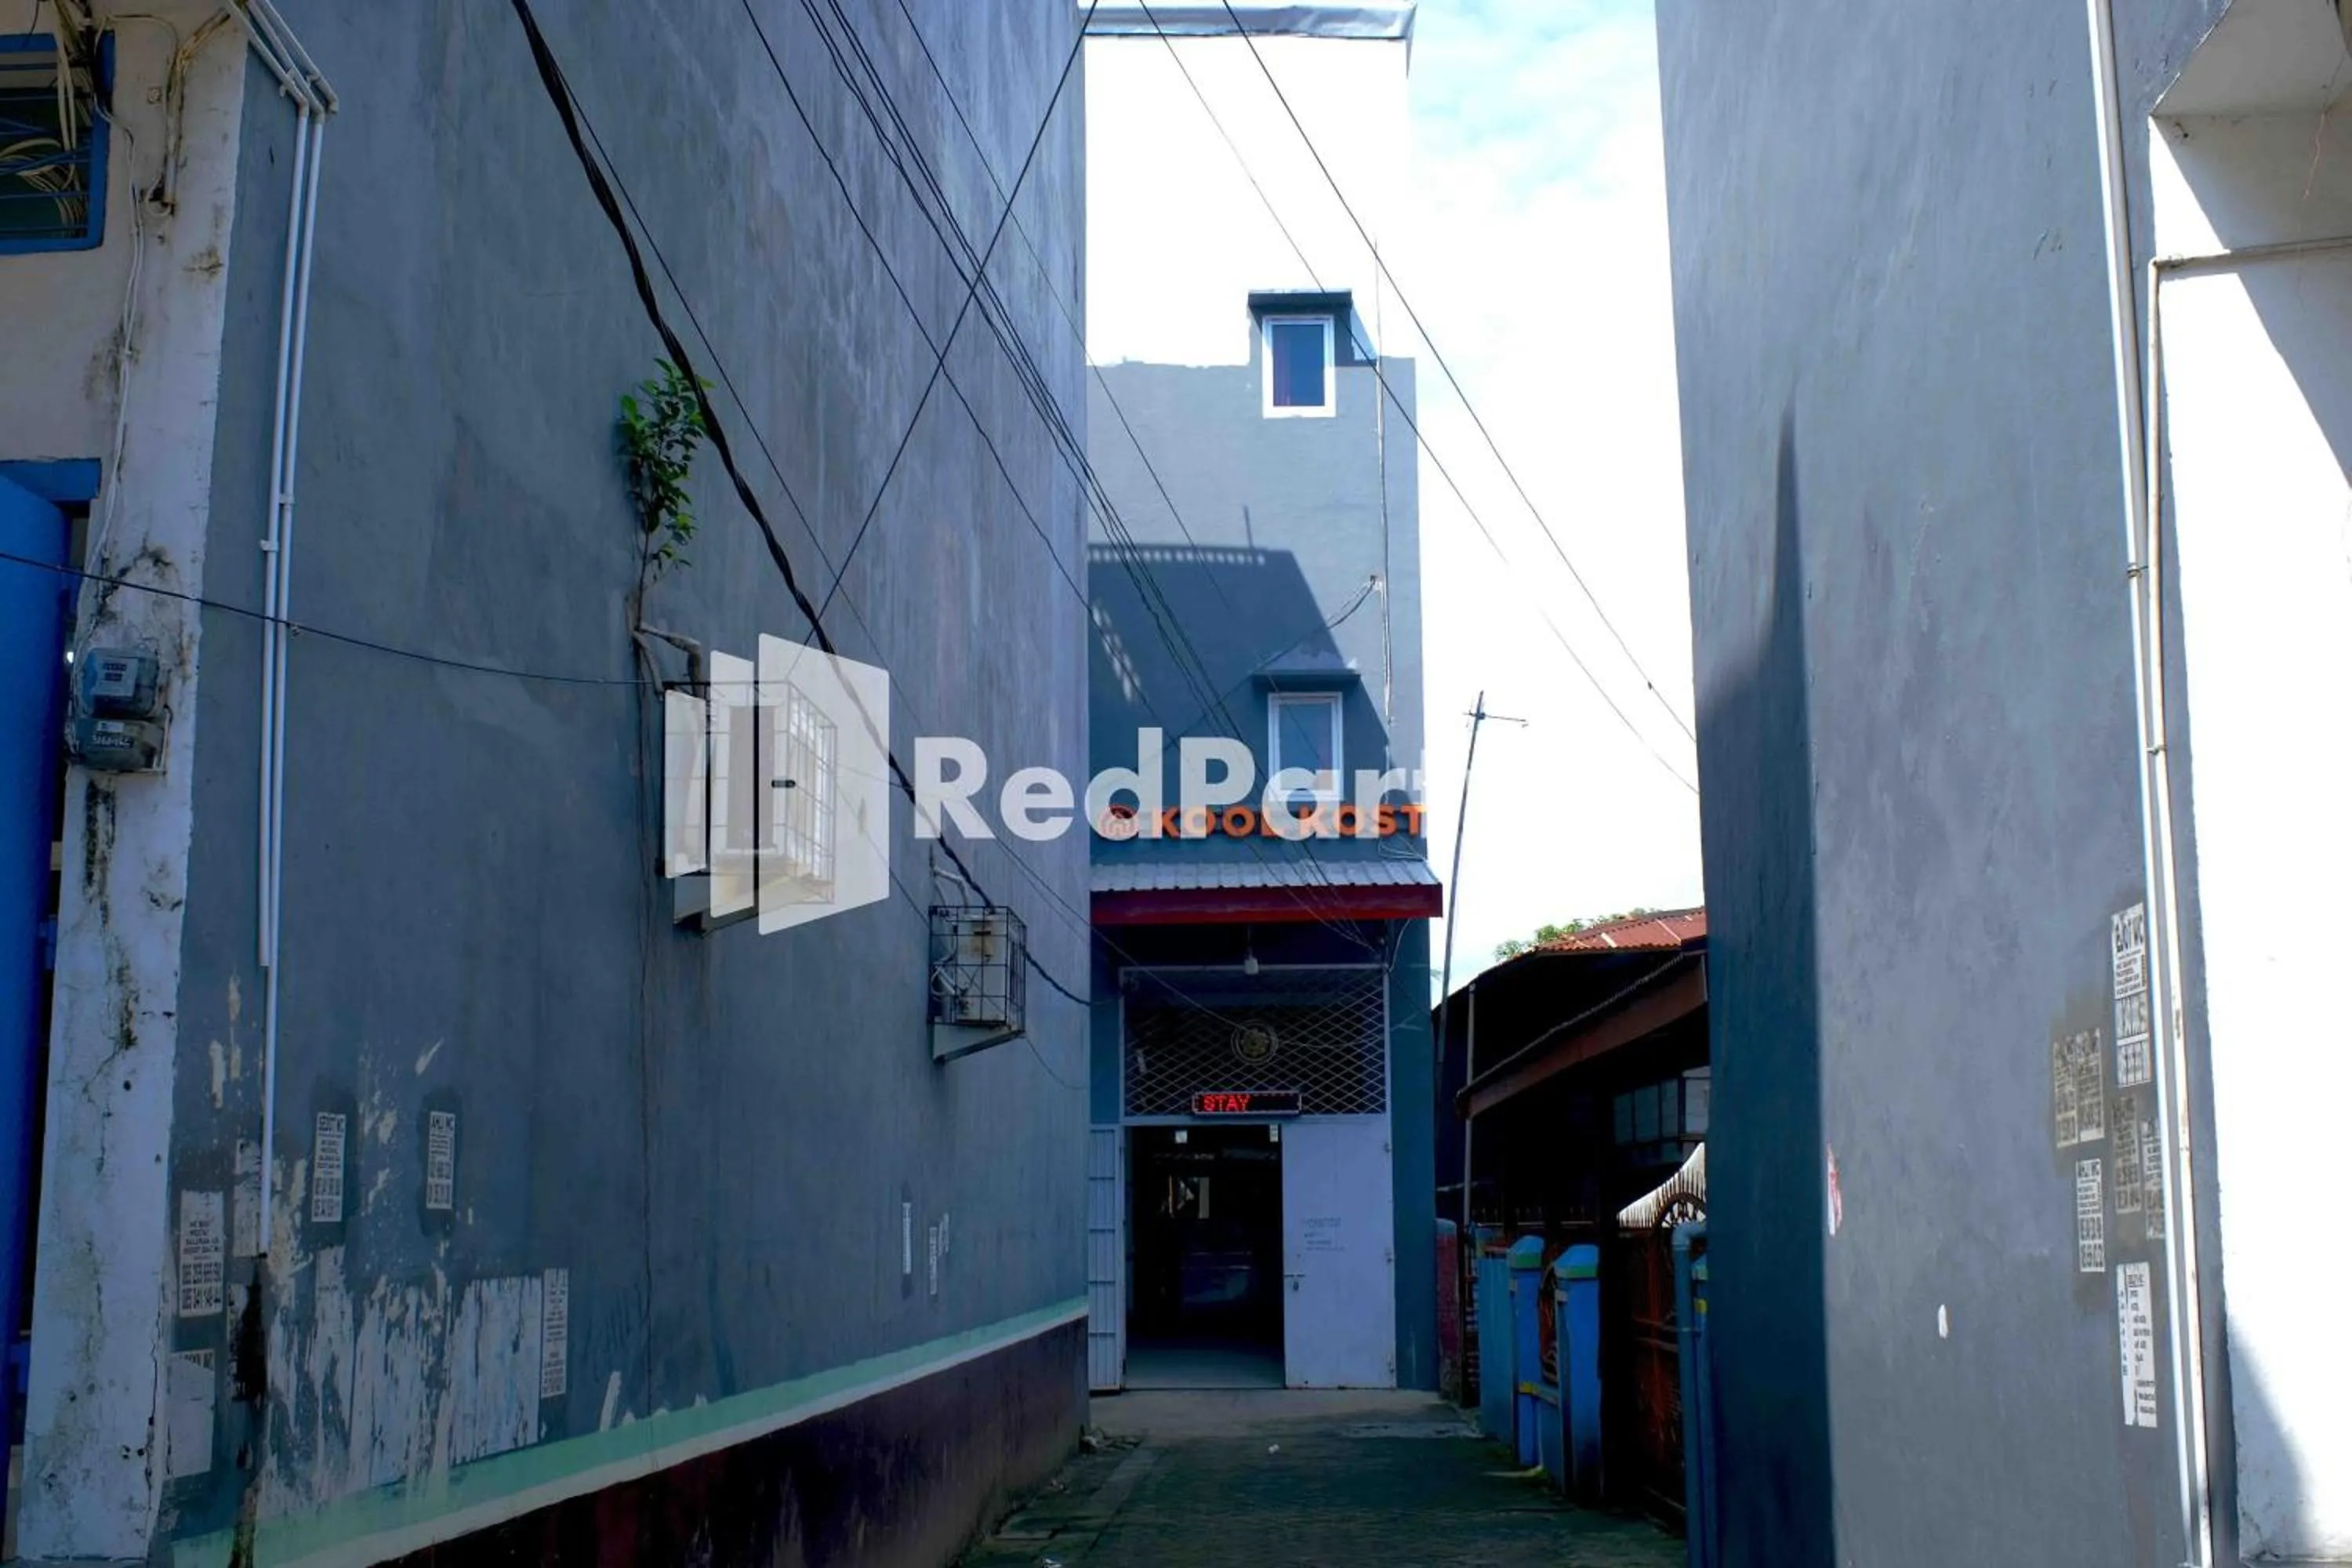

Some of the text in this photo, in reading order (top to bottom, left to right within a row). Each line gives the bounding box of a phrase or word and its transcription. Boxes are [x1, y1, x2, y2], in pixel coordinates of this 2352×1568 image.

[1152, 804, 1428, 838] KOOL KOST
[1203, 1094, 1251, 1112] STAY
